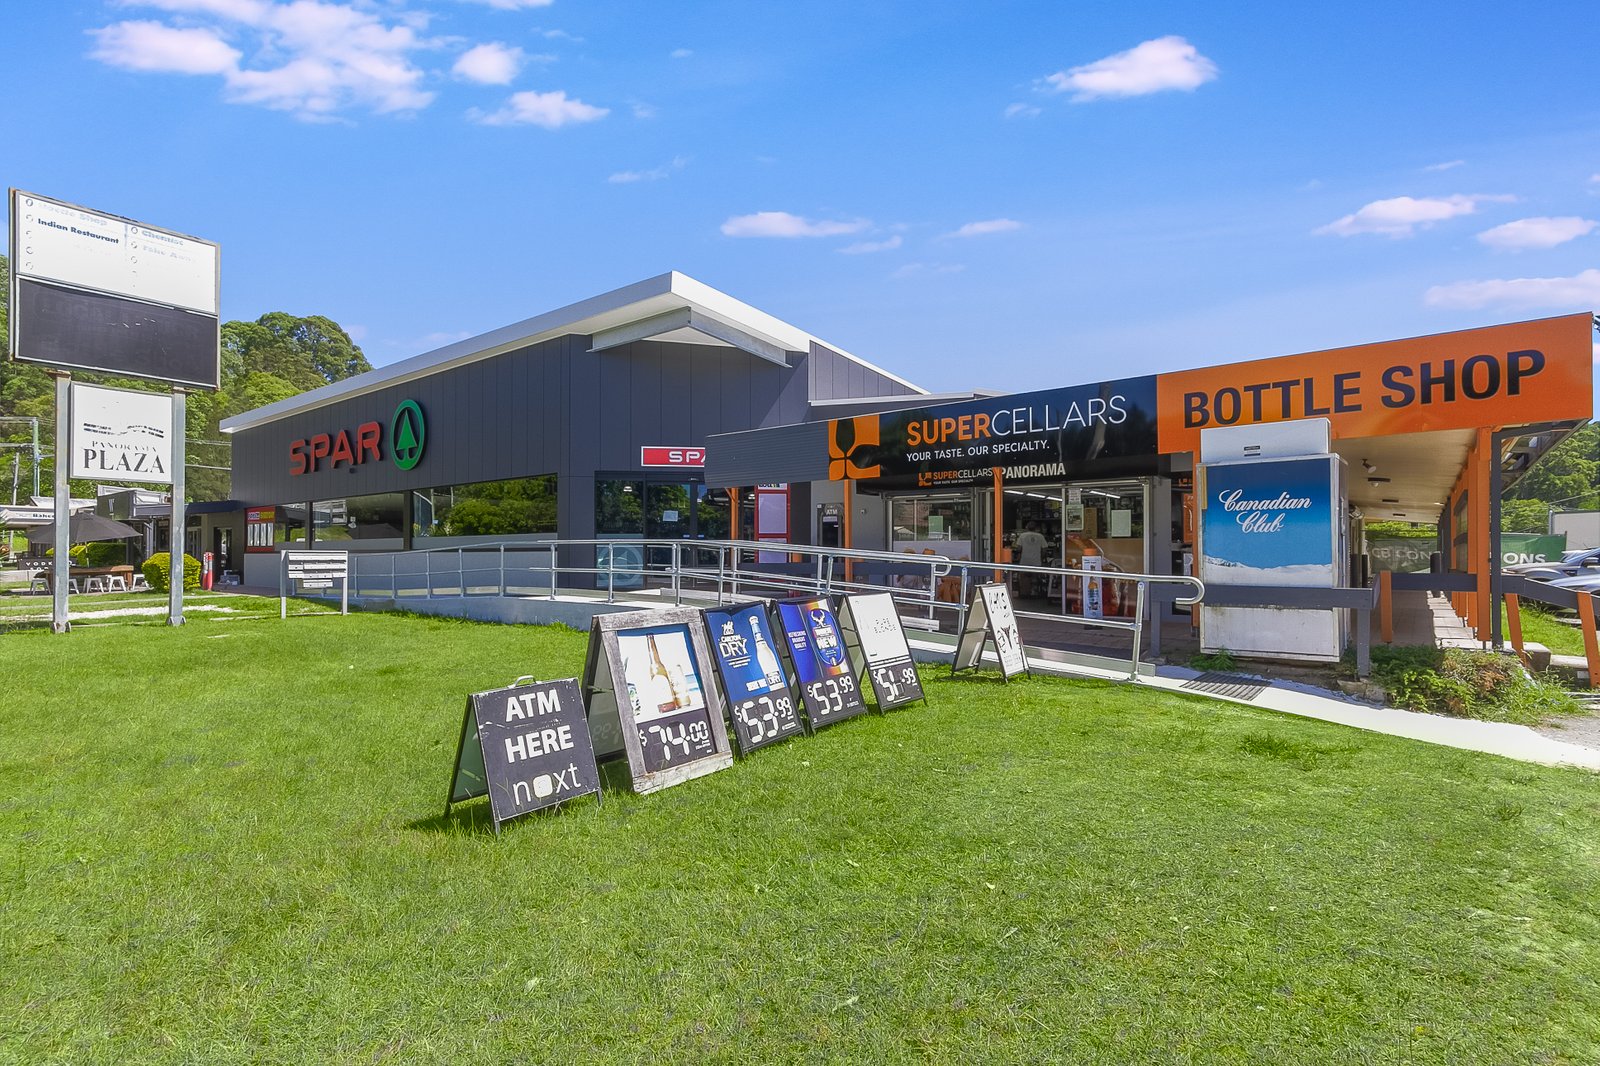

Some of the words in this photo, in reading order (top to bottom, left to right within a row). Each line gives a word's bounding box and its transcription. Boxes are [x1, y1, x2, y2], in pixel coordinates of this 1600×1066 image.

[37, 218, 69, 232] Indian
[70, 226, 120, 244] Restaurant
[1183, 371, 1363, 429] BOTTLE
[1380, 349, 1546, 410] SHOP
[906, 395, 1128, 447] SUPERCELLARS
[83, 448, 165, 474] PLAZA
[289, 421, 381, 476] SPAR
[906, 452, 931, 462] YOUR
[934, 448, 965, 460] TASTE.
[967, 445, 989, 457] OUR
[992, 440, 1050, 455] SPECIALTY.
[933, 467, 994, 480] SUPERCELLARS
[1218, 488, 1313, 512] Canadian
[1236, 511, 1286, 534] Club
[1501, 552, 1547, 564] ONS
[719, 638, 749, 658] DRY
[816, 635, 838, 649] NEW
[505, 688, 562, 723] ATM
[807, 676, 854, 715] $53.99
[504, 725, 574, 763] HERE
[639, 720, 709, 761] $74.00
